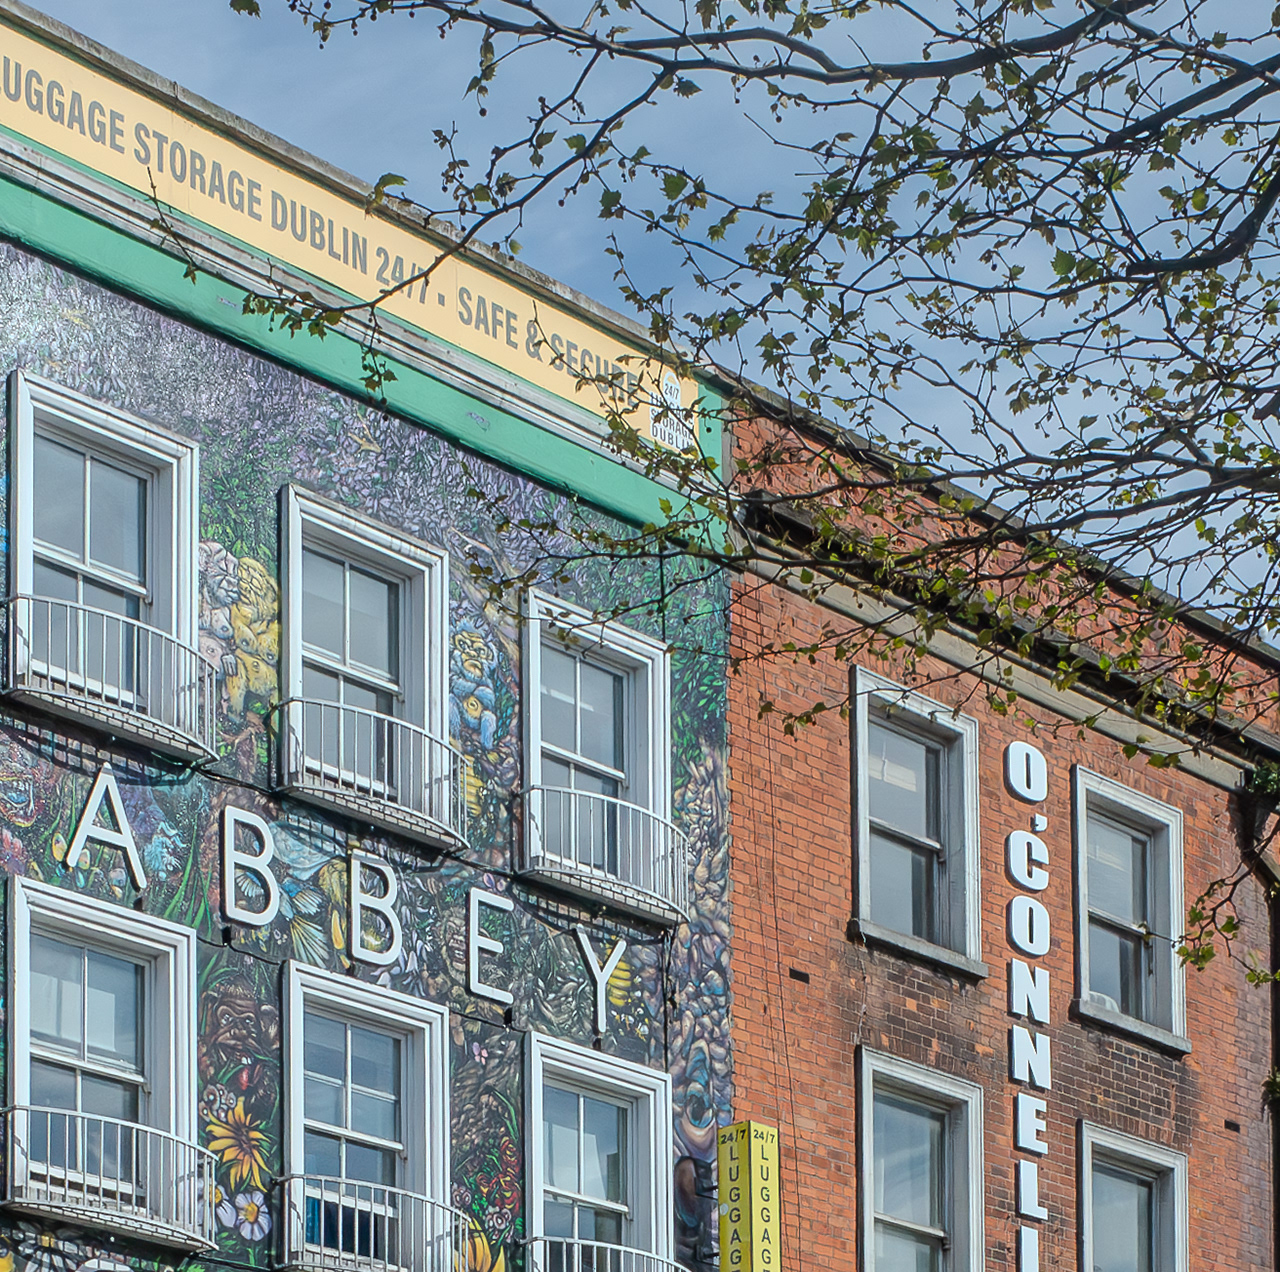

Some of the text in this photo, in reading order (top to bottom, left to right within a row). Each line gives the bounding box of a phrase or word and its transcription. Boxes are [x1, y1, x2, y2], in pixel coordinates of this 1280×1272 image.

[133, 122, 262, 222] STORAGE
[270, 190, 368, 275] DUBLIN
[375, 246, 428, 306] 24/7
[458, 286, 518, 350] SAFE
[526, 319, 543, 363] &
[550, 333, 639, 407] SECURE
[664, 383, 680, 400] 24/7
[64, 762, 628, 1035] ABBEY
[721, 1129, 746, 1145] 24/7
[753, 1129, 775, 1144] 24/7
